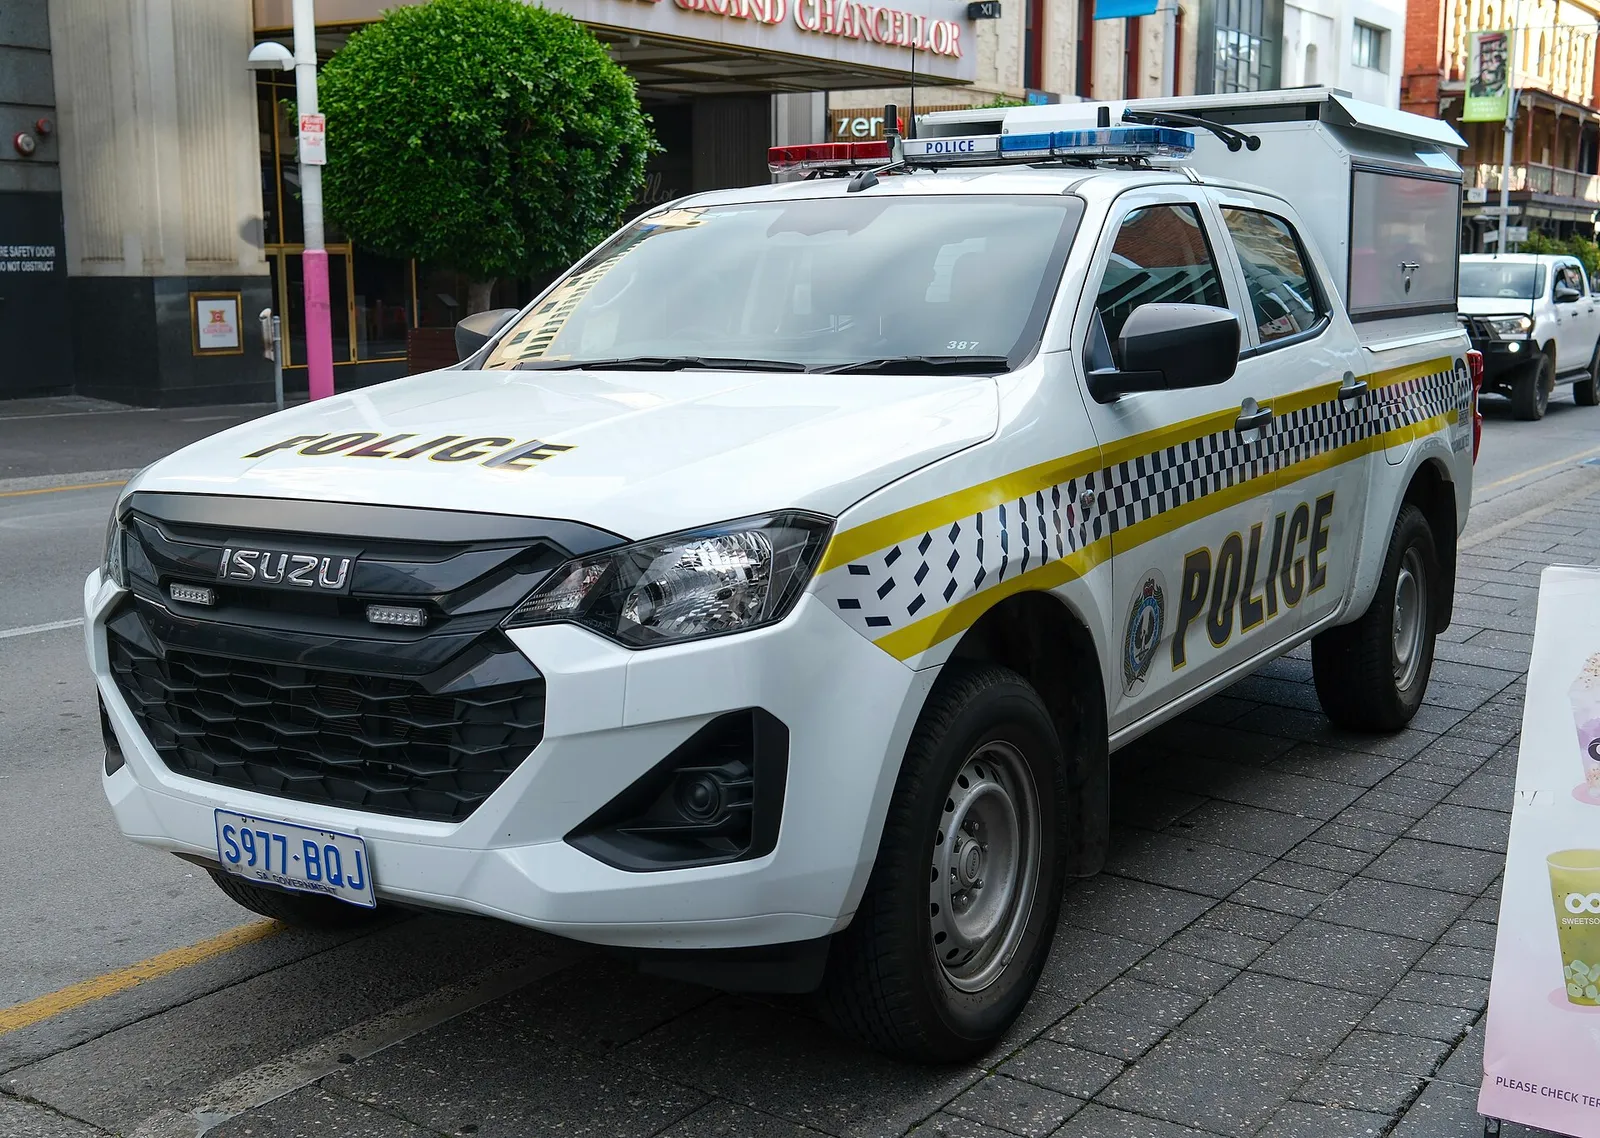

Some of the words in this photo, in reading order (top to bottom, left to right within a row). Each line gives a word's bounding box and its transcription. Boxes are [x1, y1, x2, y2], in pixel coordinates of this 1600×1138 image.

[793, 0, 963, 58] CHANCELLOR
[926, 140, 975, 153] POLICE
[9, 246, 35, 257] SAFETY
[36, 246, 56, 258] DOOR
[7, 261, 20, 271] NOT
[21, 261, 54, 272] OBSTRUCT
[946, 340, 980, 350] 387
[240, 432, 579, 472] POLICE
[219, 548, 351, 589] ISUZU
[1171, 490, 1335, 672] POLICE
[255, 870, 269, 879] SA
[272, 874, 337, 894] GOVERNMENT
[1496, 1076, 1538, 1094] PLEASE
[1541, 1086, 1579, 1103] CHECK
